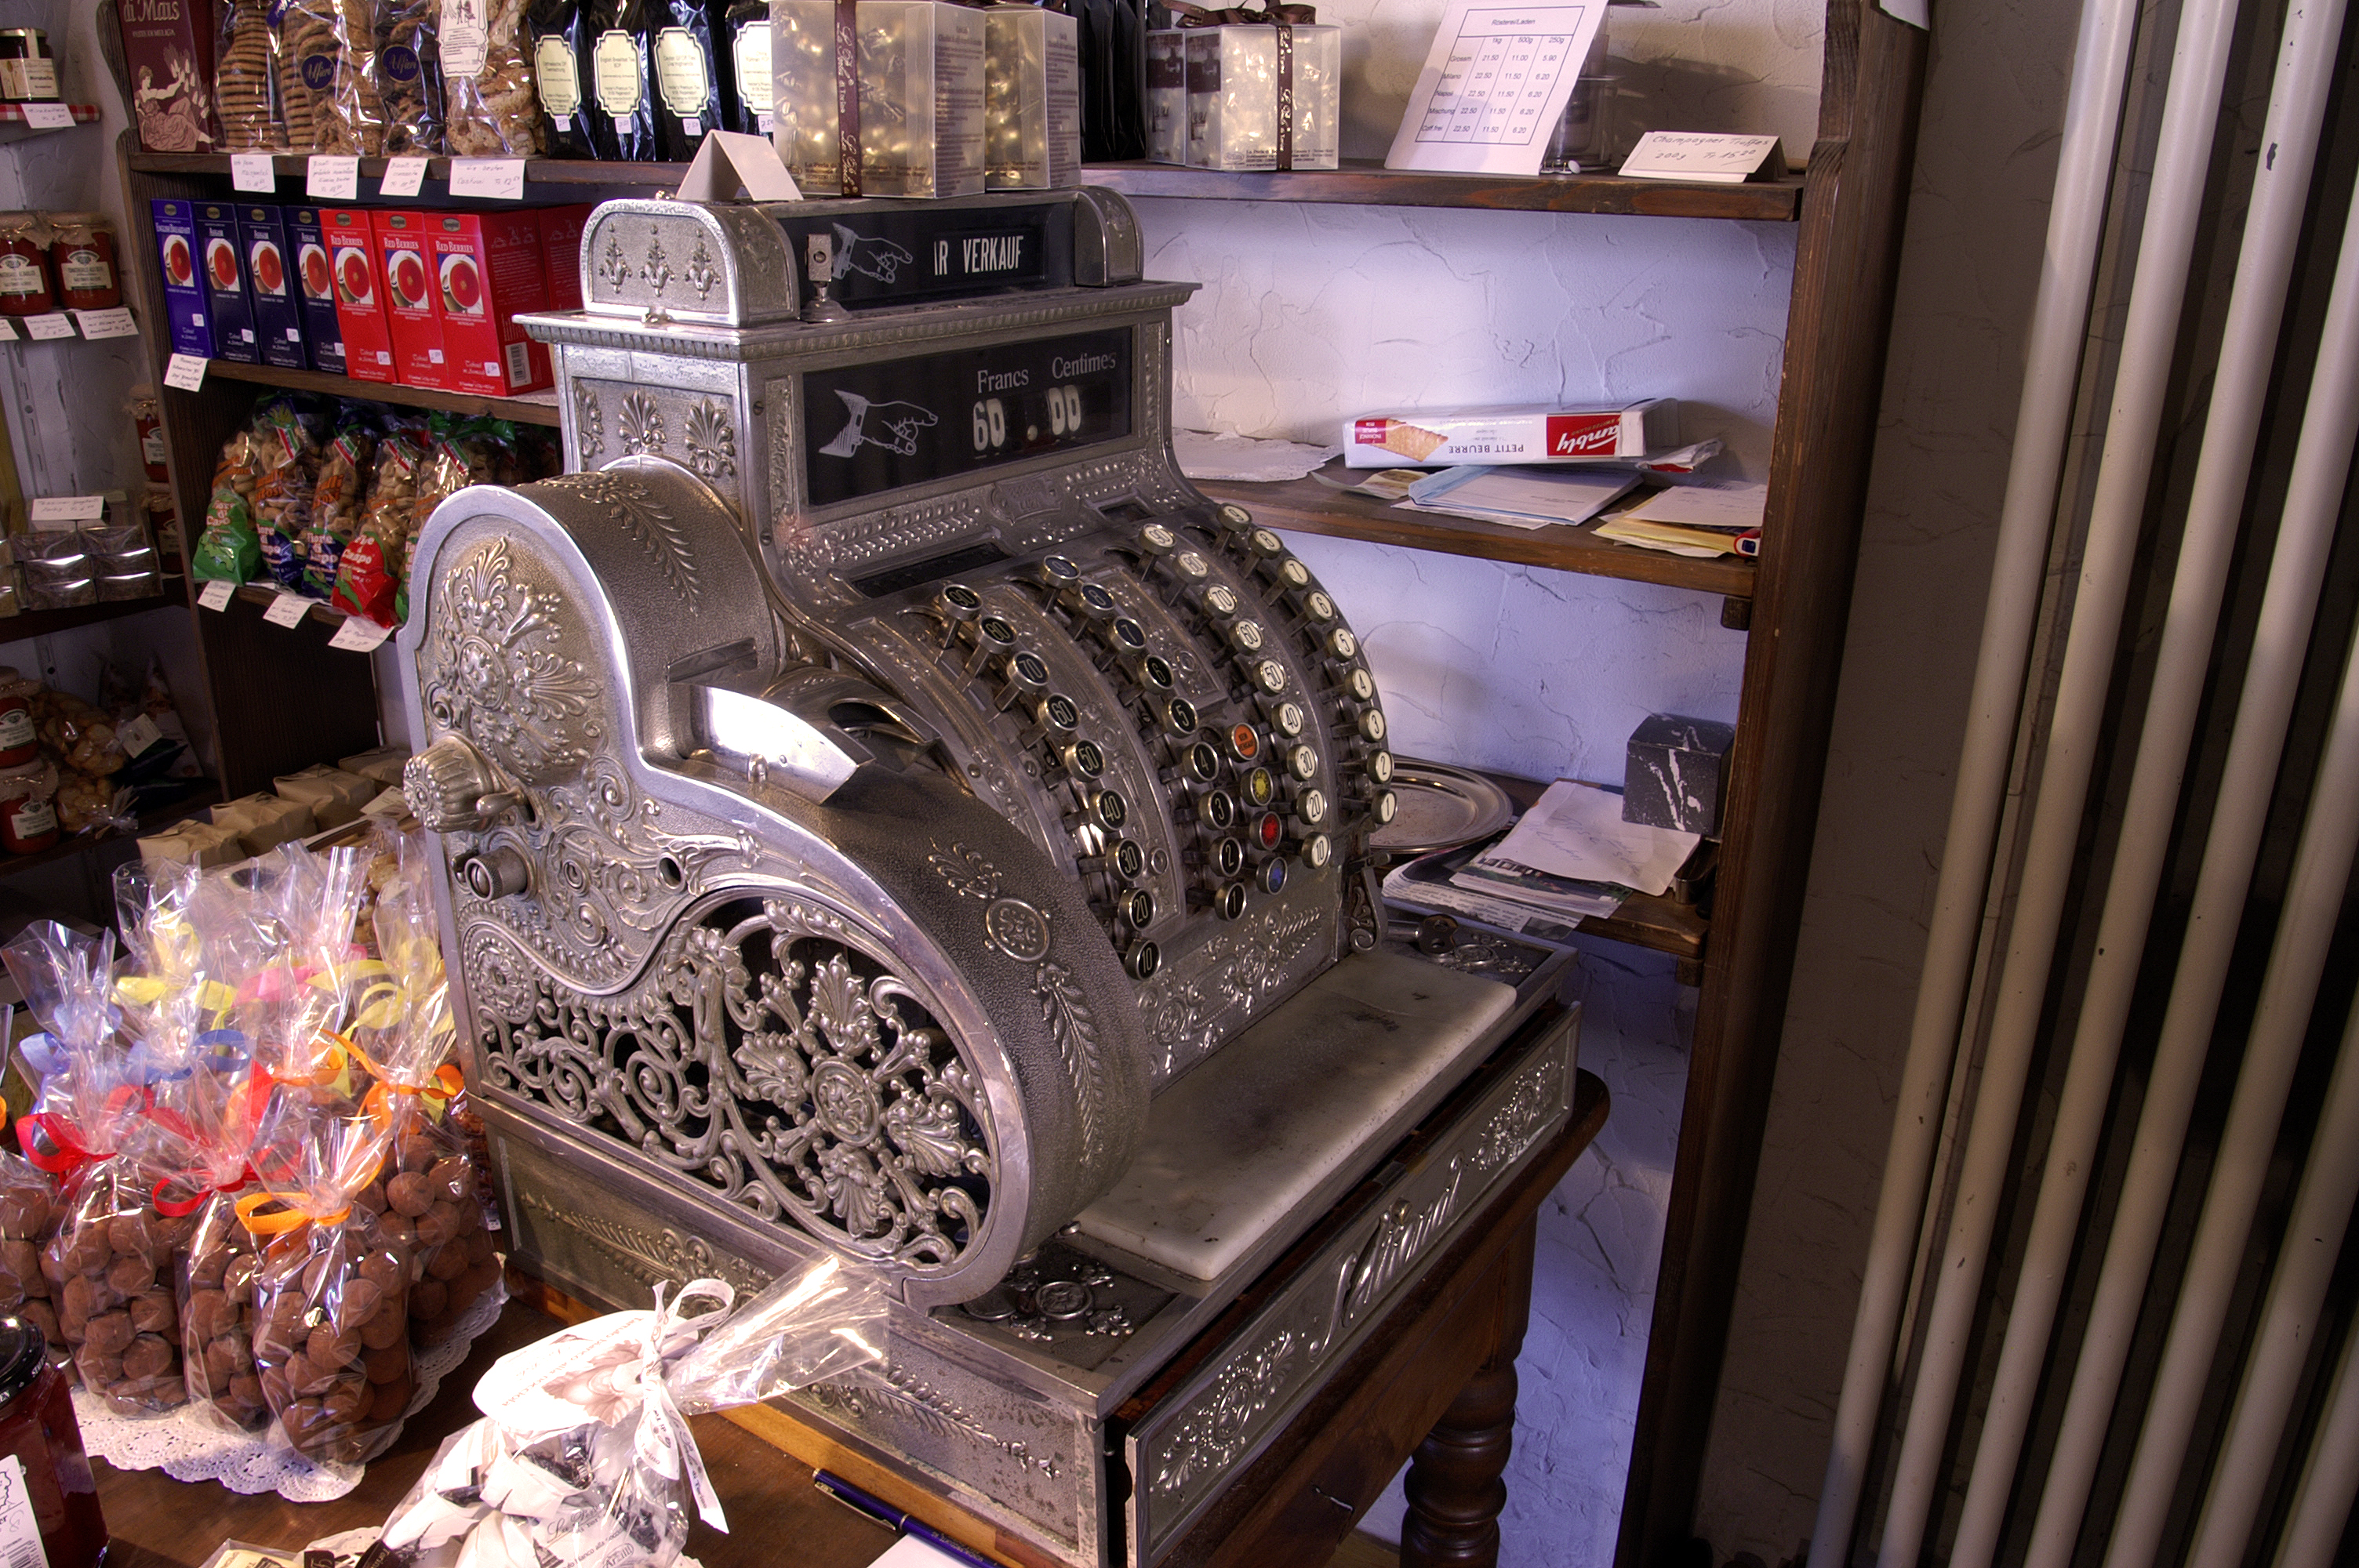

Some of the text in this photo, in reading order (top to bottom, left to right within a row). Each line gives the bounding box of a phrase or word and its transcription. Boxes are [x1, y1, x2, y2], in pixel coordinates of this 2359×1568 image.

[1548, 36, 1565, 45] 250g
[1652, 135, 1725, 146] Champagner
[330, 234, 364, 247] RED BERRIES
[383, 237, 420, 249] RED BERRIES
[435, 240, 474, 253] RED BERRIES
[963, 236, 1024, 274] VERKAUF
[977, 353, 1117, 394] Francs Centimes
[972, 384, 1081, 452] 60 00
[1448, 444, 1524, 454] PETIT BEURRE
[1228, 508, 1244, 521] 9
[1148, 528, 1170, 543] 90
[1259, 533, 1274, 548] 8
[948, 589, 976, 606] 90
[1088, 590, 1107, 605] 8
[1212, 590, 1233, 610] 70
[1315, 597, 1329, 614] 6
[985, 621, 1011, 641] 80
[1121, 624, 1137, 643] 7
[1239, 624, 1259, 644] 60
[1339, 633, 1350, 652] 5
[1020, 658, 1043, 679] 70
[1151, 662, 1166, 683] 6
[1264, 665, 1282, 688] 50
[1359, 673, 1366, 693] 4
[1051, 699, 1074, 724] 60
[1176, 705, 1189, 727] 5
[1285, 707, 1299, 730] 40
[1371, 714, 1379, 735] 3
[1078, 746, 1100, 771] 50
[1199, 750, 1209, 771] 4
[1299, 750, 1310, 773] 30
[1380, 755, 1387, 776] 2
[1104, 794, 1121, 822] 40
[1216, 799, 1225, 820] 3
[1311, 793, 1321, 818] 20
[1121, 846, 1138, 874] 30
[1225, 844, 1234, 867] 2
[1316, 840, 1325, 860] 10
[1136, 895, 1148, 923] 20
[1142, 947, 1153, 972] 10
